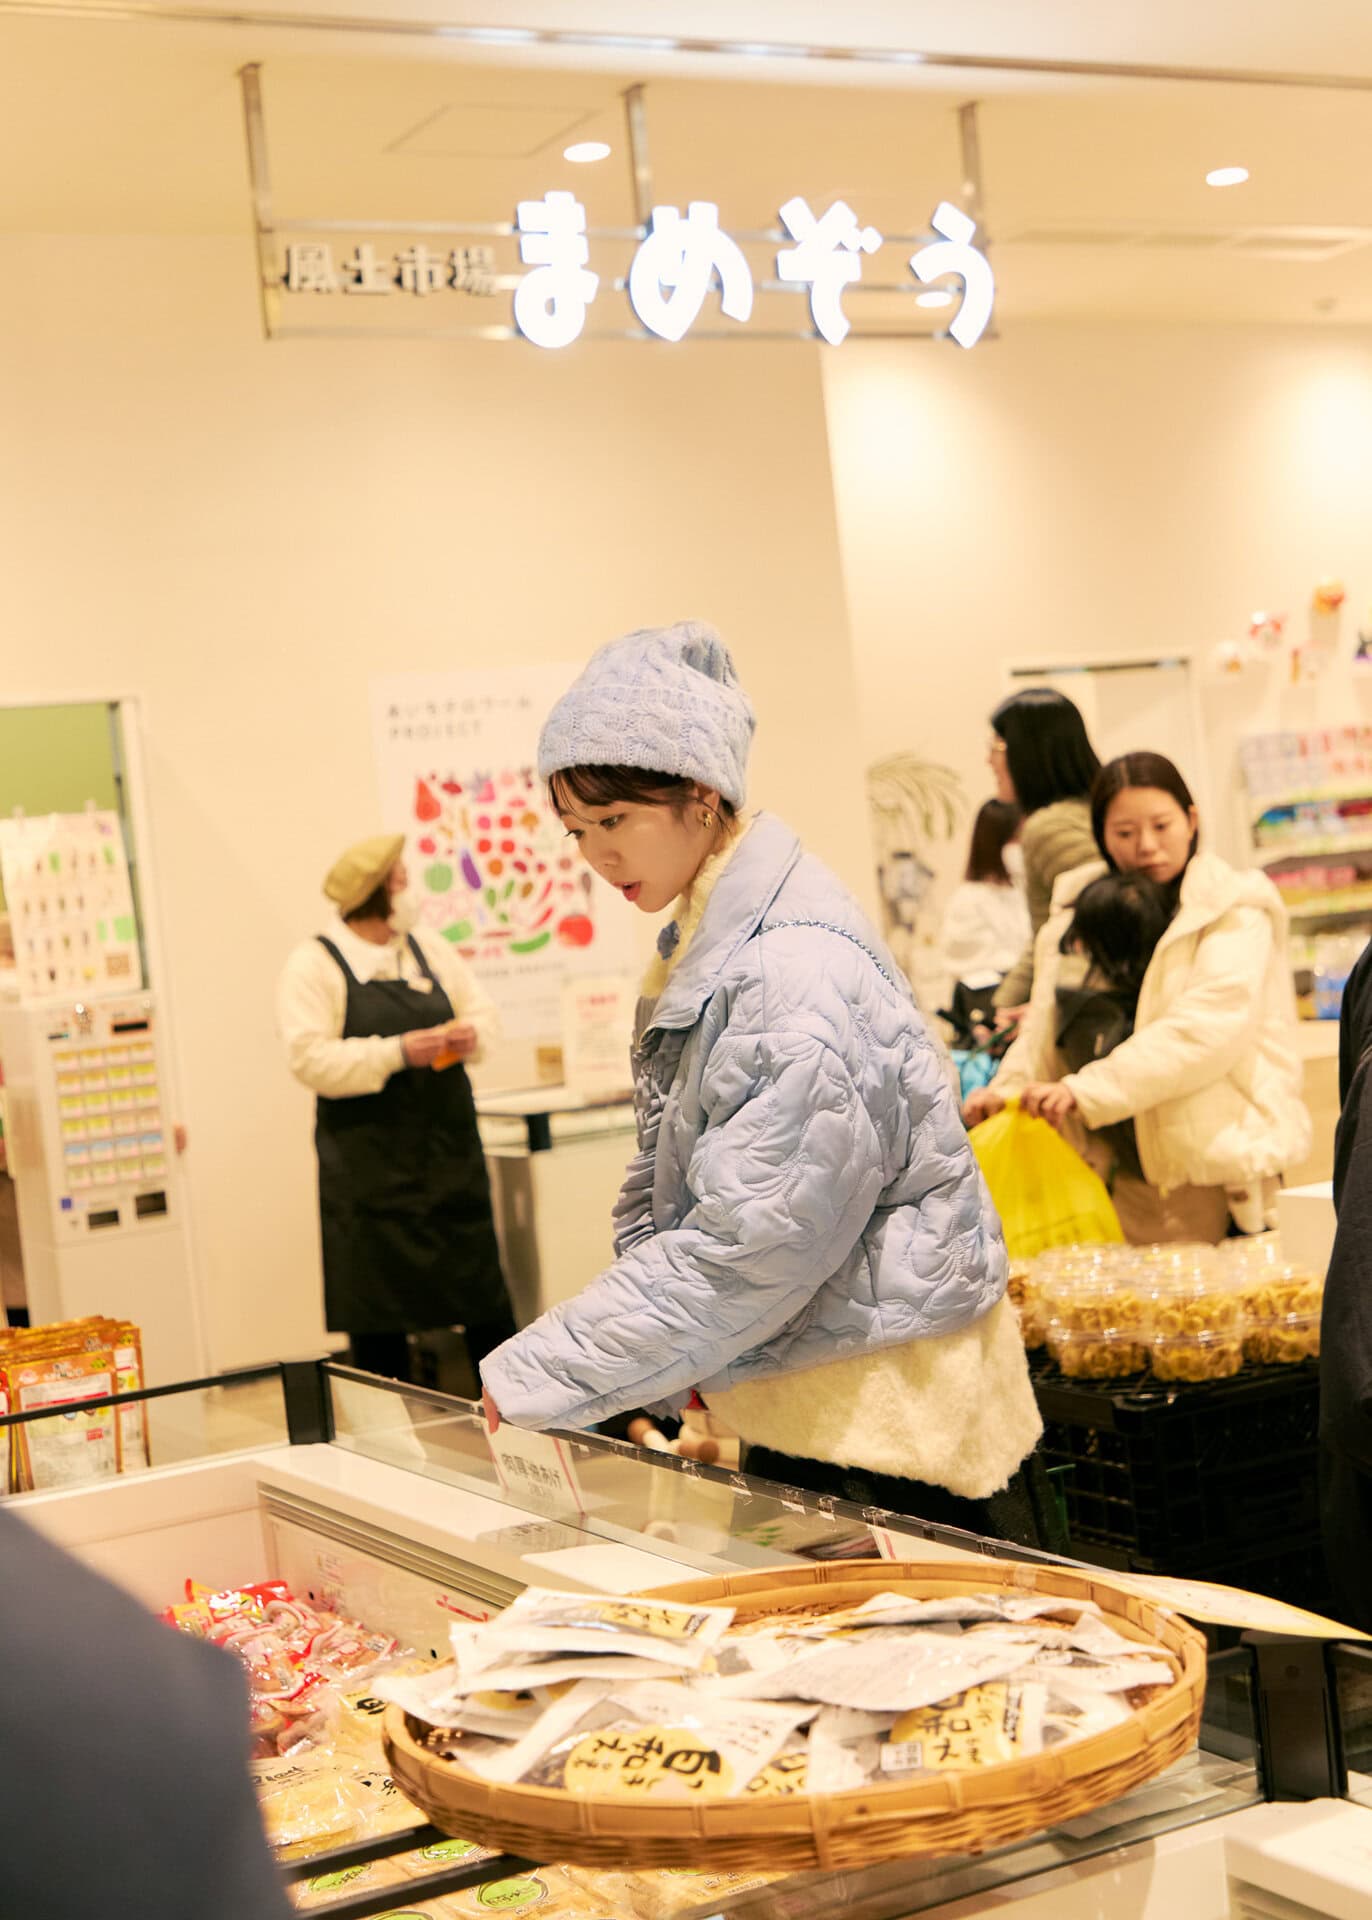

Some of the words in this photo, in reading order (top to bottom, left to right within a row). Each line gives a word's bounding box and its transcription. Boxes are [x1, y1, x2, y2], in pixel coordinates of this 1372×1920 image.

[284, 242, 496, 296] 風土市場
[514, 190, 995, 349] まめぞう
